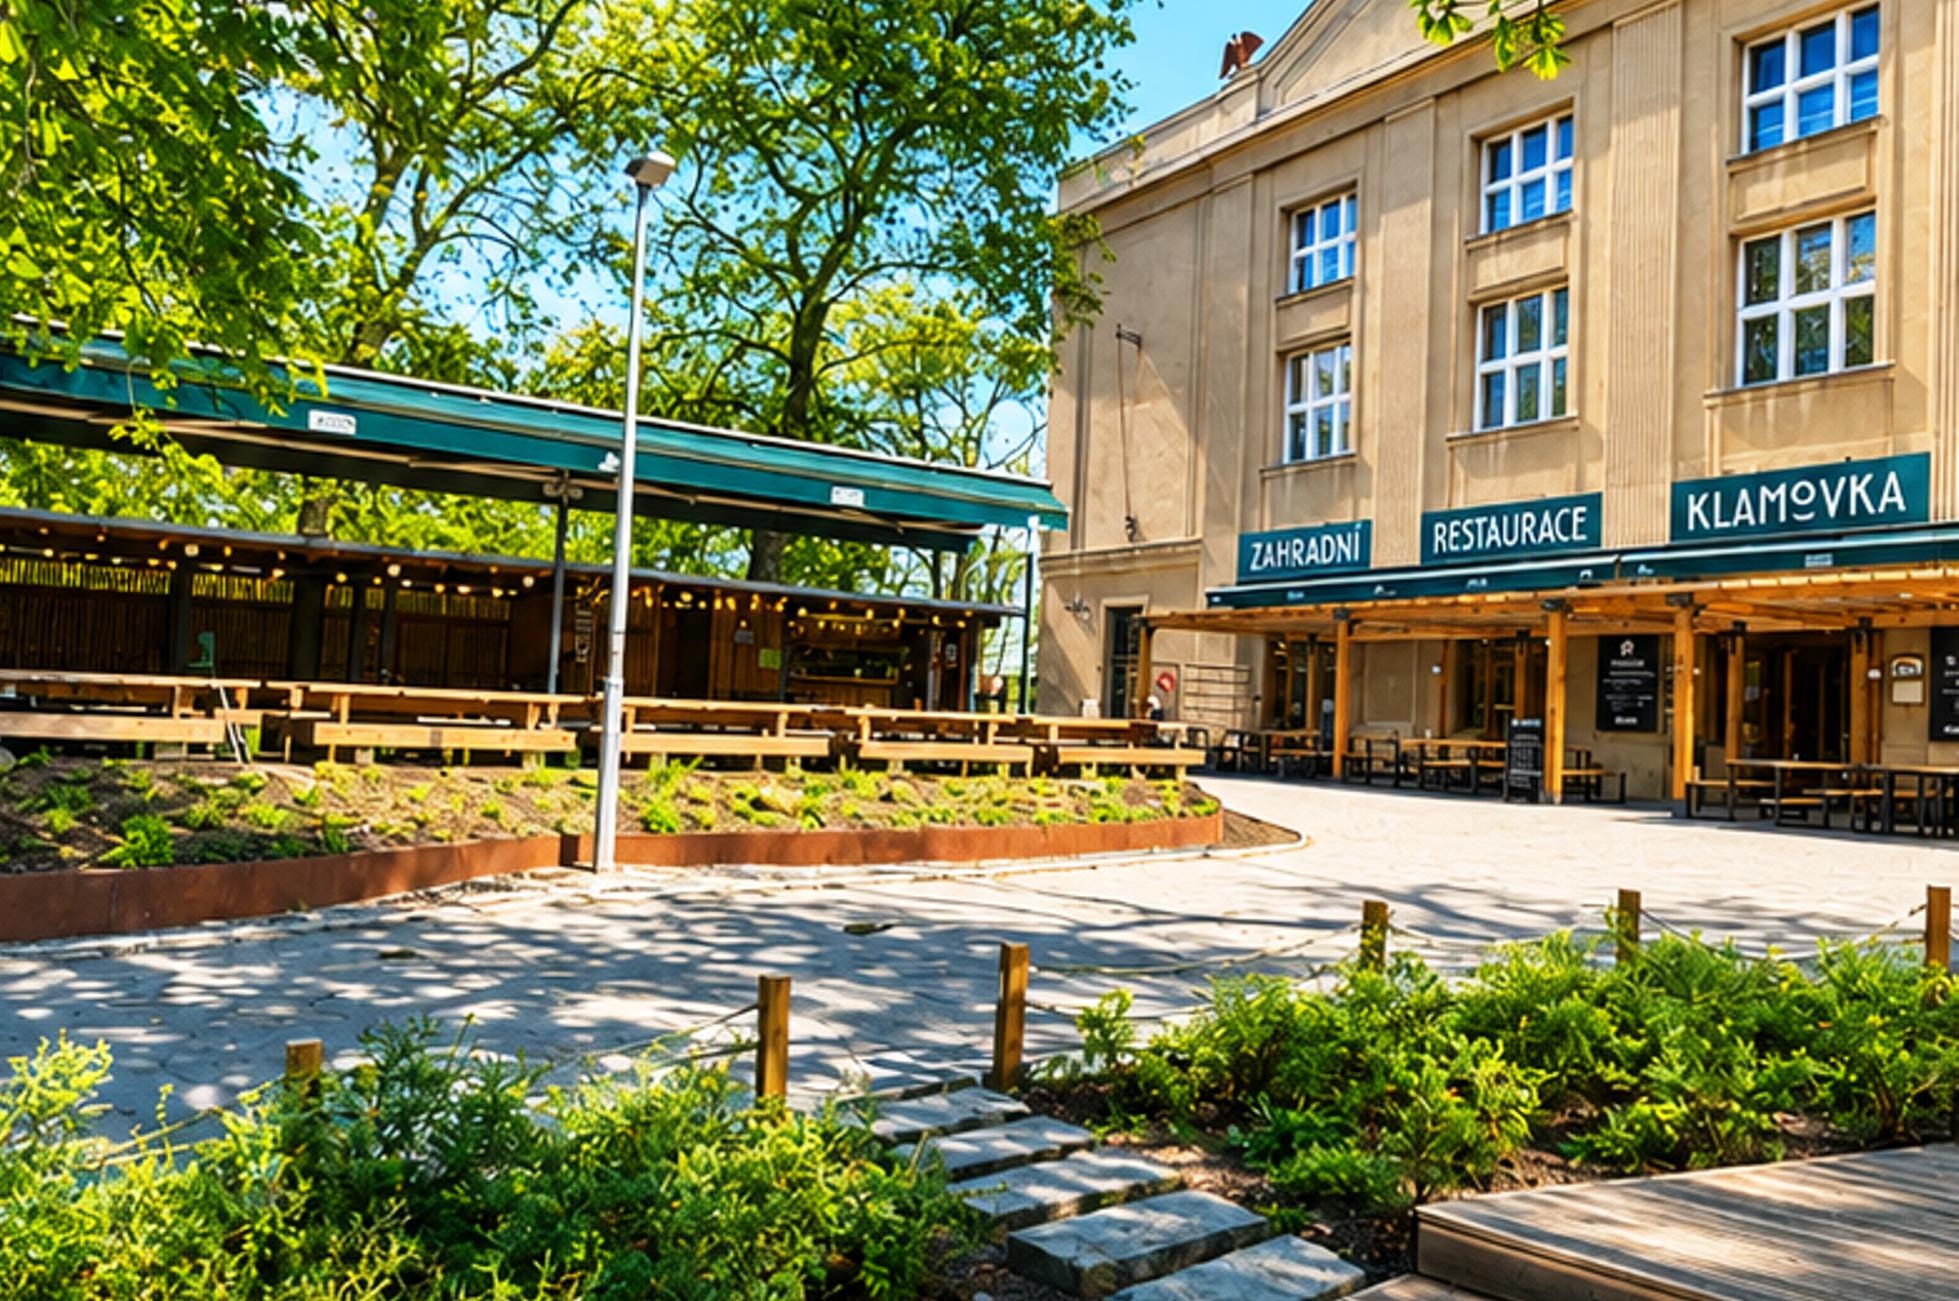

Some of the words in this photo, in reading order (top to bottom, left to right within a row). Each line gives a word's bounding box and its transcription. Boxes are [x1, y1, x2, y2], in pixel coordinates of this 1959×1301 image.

[1250, 524, 1360, 570] ZAHRADNÍ
[1433, 506, 1587, 554] RESTAURACE
[1687, 471, 1906, 531] KLAMOVKA
